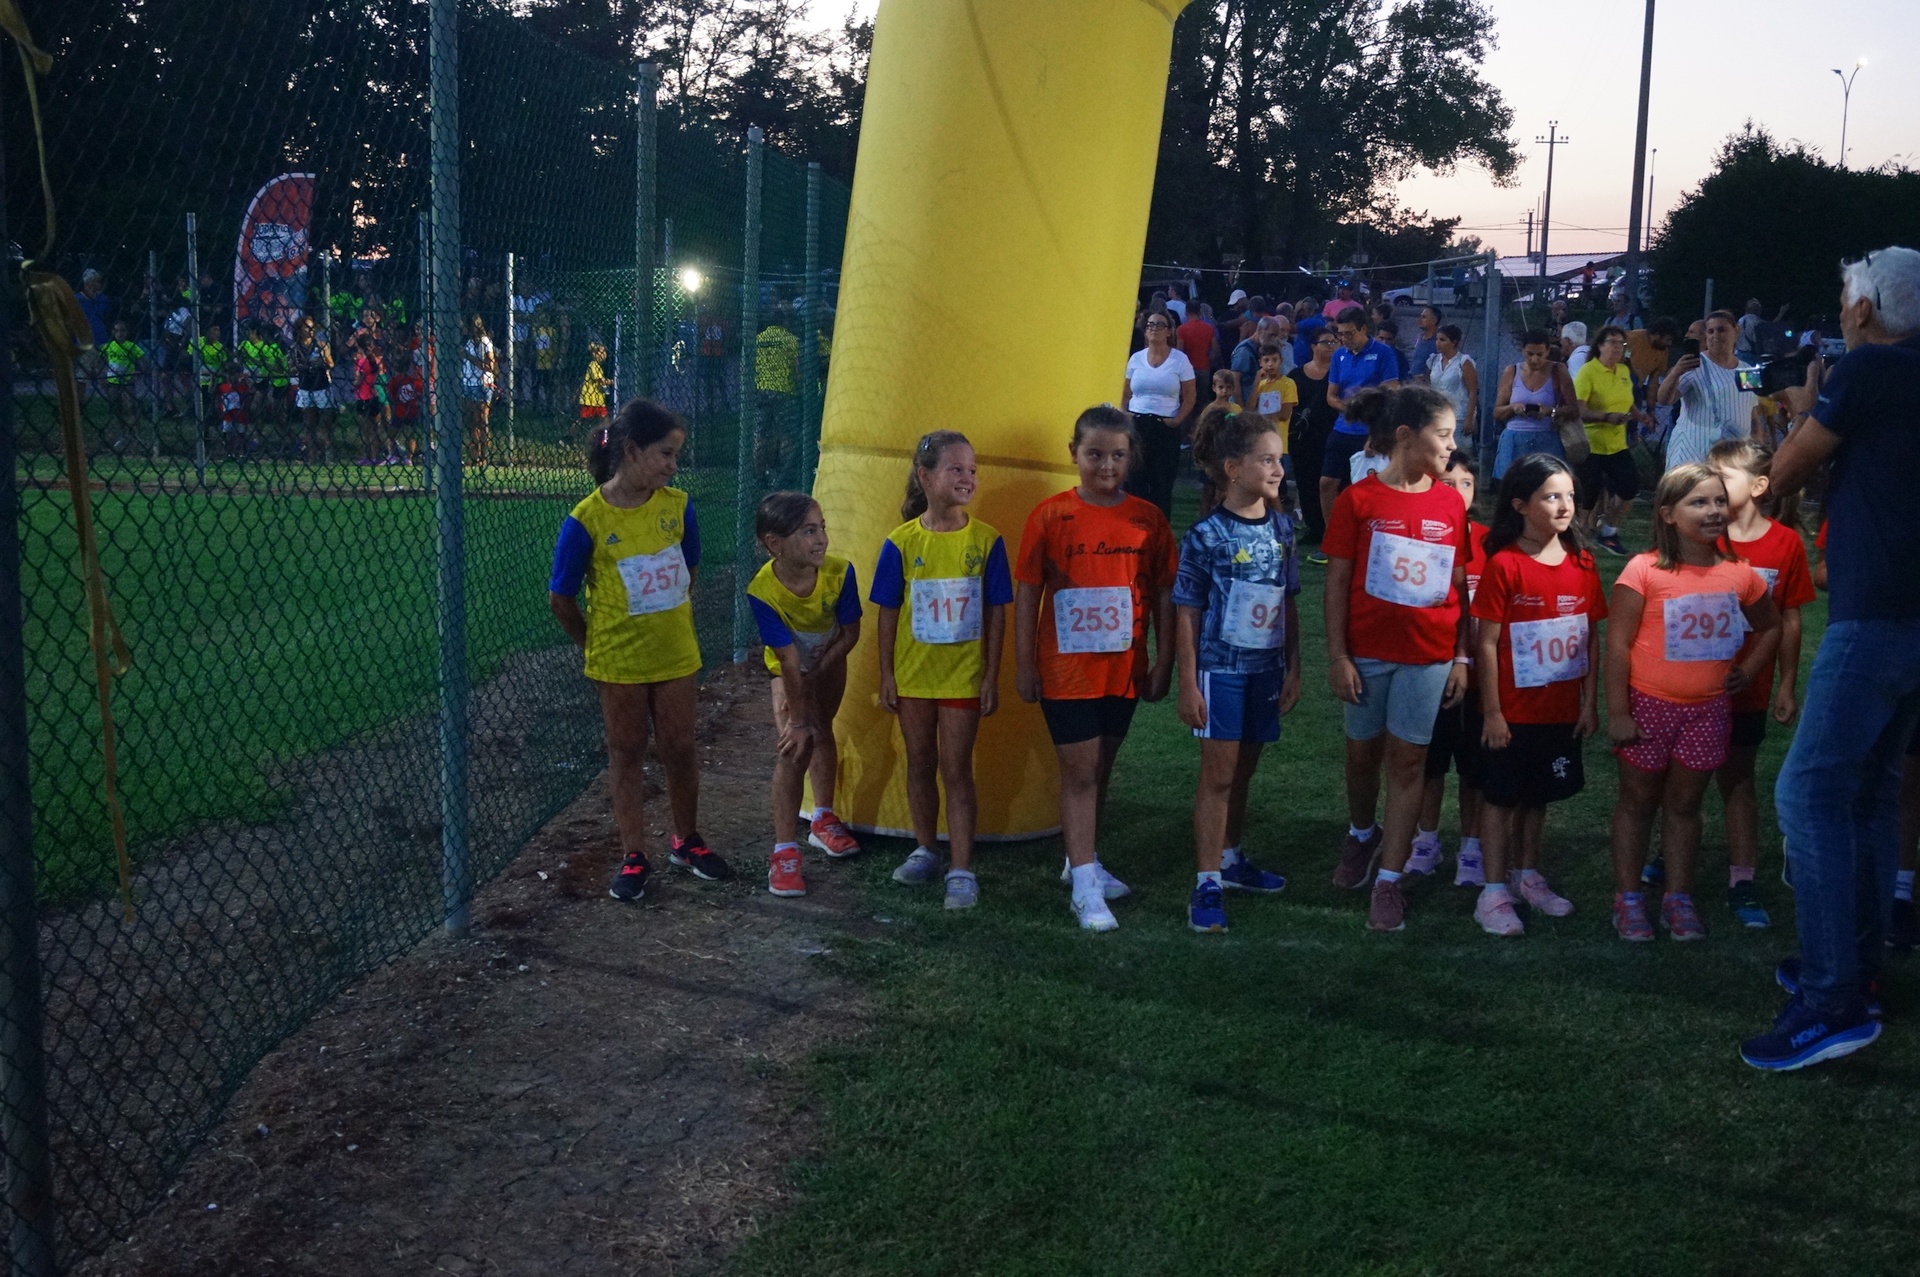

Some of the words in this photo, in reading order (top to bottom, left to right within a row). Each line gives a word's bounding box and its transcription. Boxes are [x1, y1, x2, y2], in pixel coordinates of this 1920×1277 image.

[638, 563, 680, 596] 257
[1392, 557, 1427, 586] 53
[928, 596, 970, 623] 117
[1069, 606, 1120, 632] 253
[1681, 612, 1732, 640] 292
[1530, 635, 1579, 666] 106
[1791, 1023, 1828, 1048] HOKA
